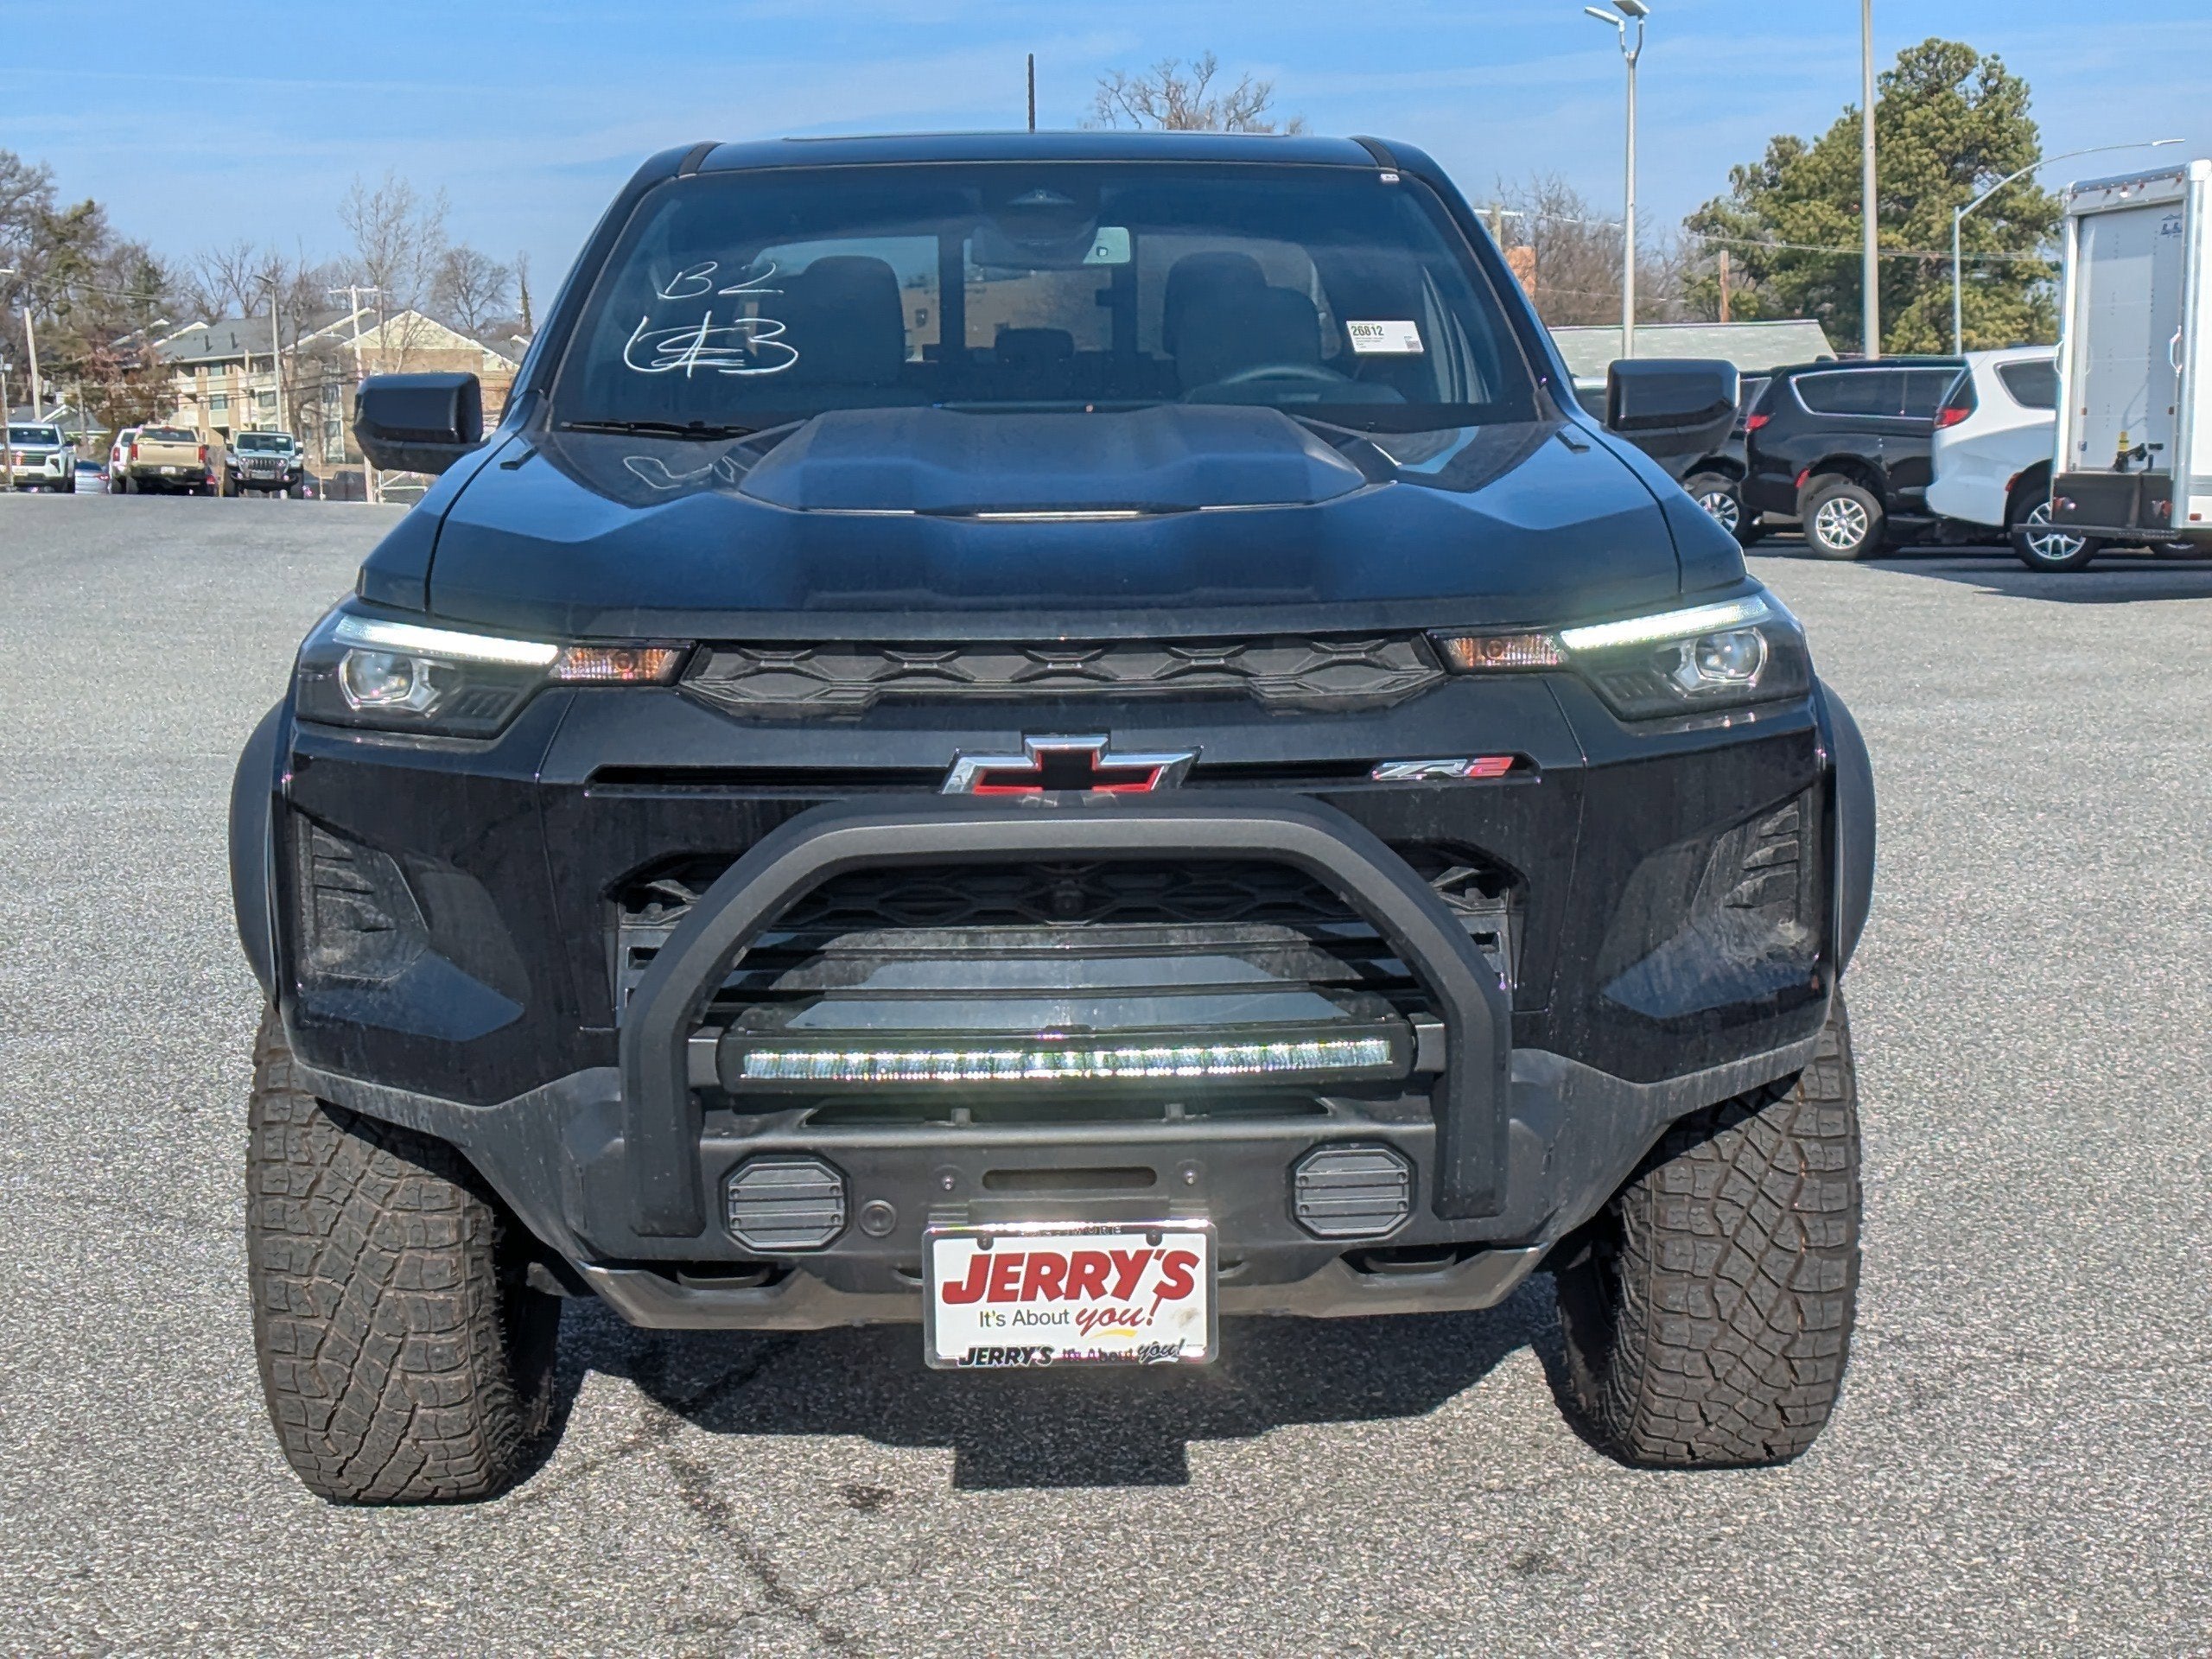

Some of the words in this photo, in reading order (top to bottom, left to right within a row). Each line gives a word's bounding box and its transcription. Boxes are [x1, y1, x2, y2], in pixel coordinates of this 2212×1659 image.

[1351, 325, 1384, 337] 26812
[1370, 756, 1514, 781] ZR2
[941, 1249, 1201, 1305] JERRY'S
[979, 1310, 1007, 1328] It's
[1012, 1307, 1070, 1326] About
[1075, 1296, 1165, 1338] you!
[958, 1344, 1055, 1367] JERRY'S
[1136, 1338, 1186, 1364] you!
